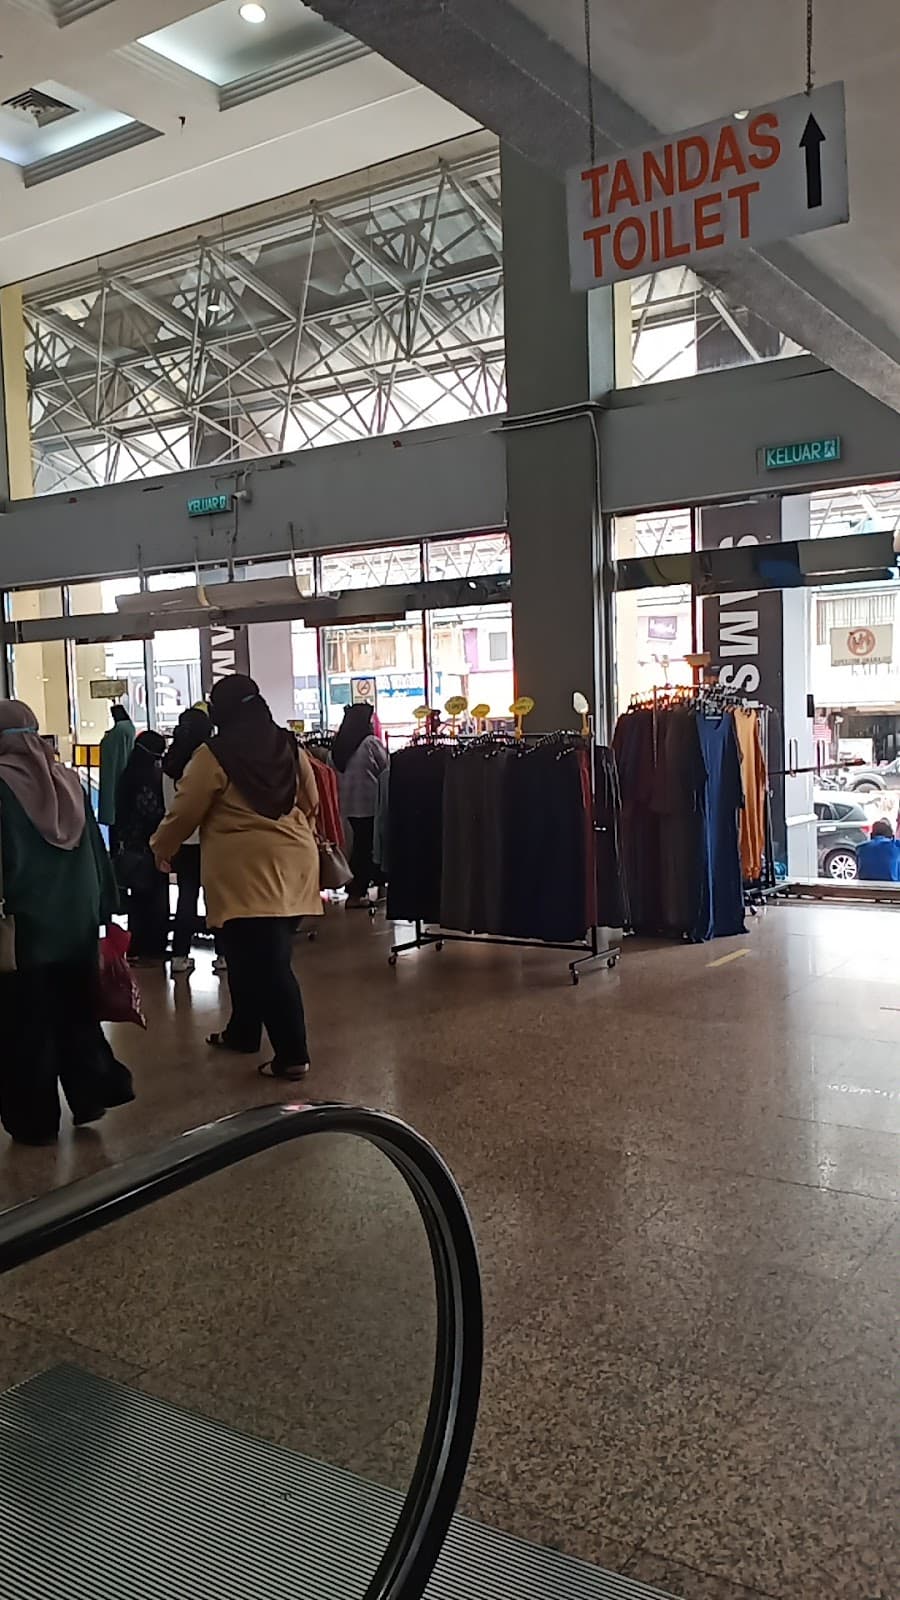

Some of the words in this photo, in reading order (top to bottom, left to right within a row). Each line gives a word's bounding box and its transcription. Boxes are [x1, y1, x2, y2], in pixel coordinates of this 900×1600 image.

[581, 113, 781, 218] TANDAS
[583, 182, 760, 278] TOILET
[766, 442, 821, 466] KELUAR
